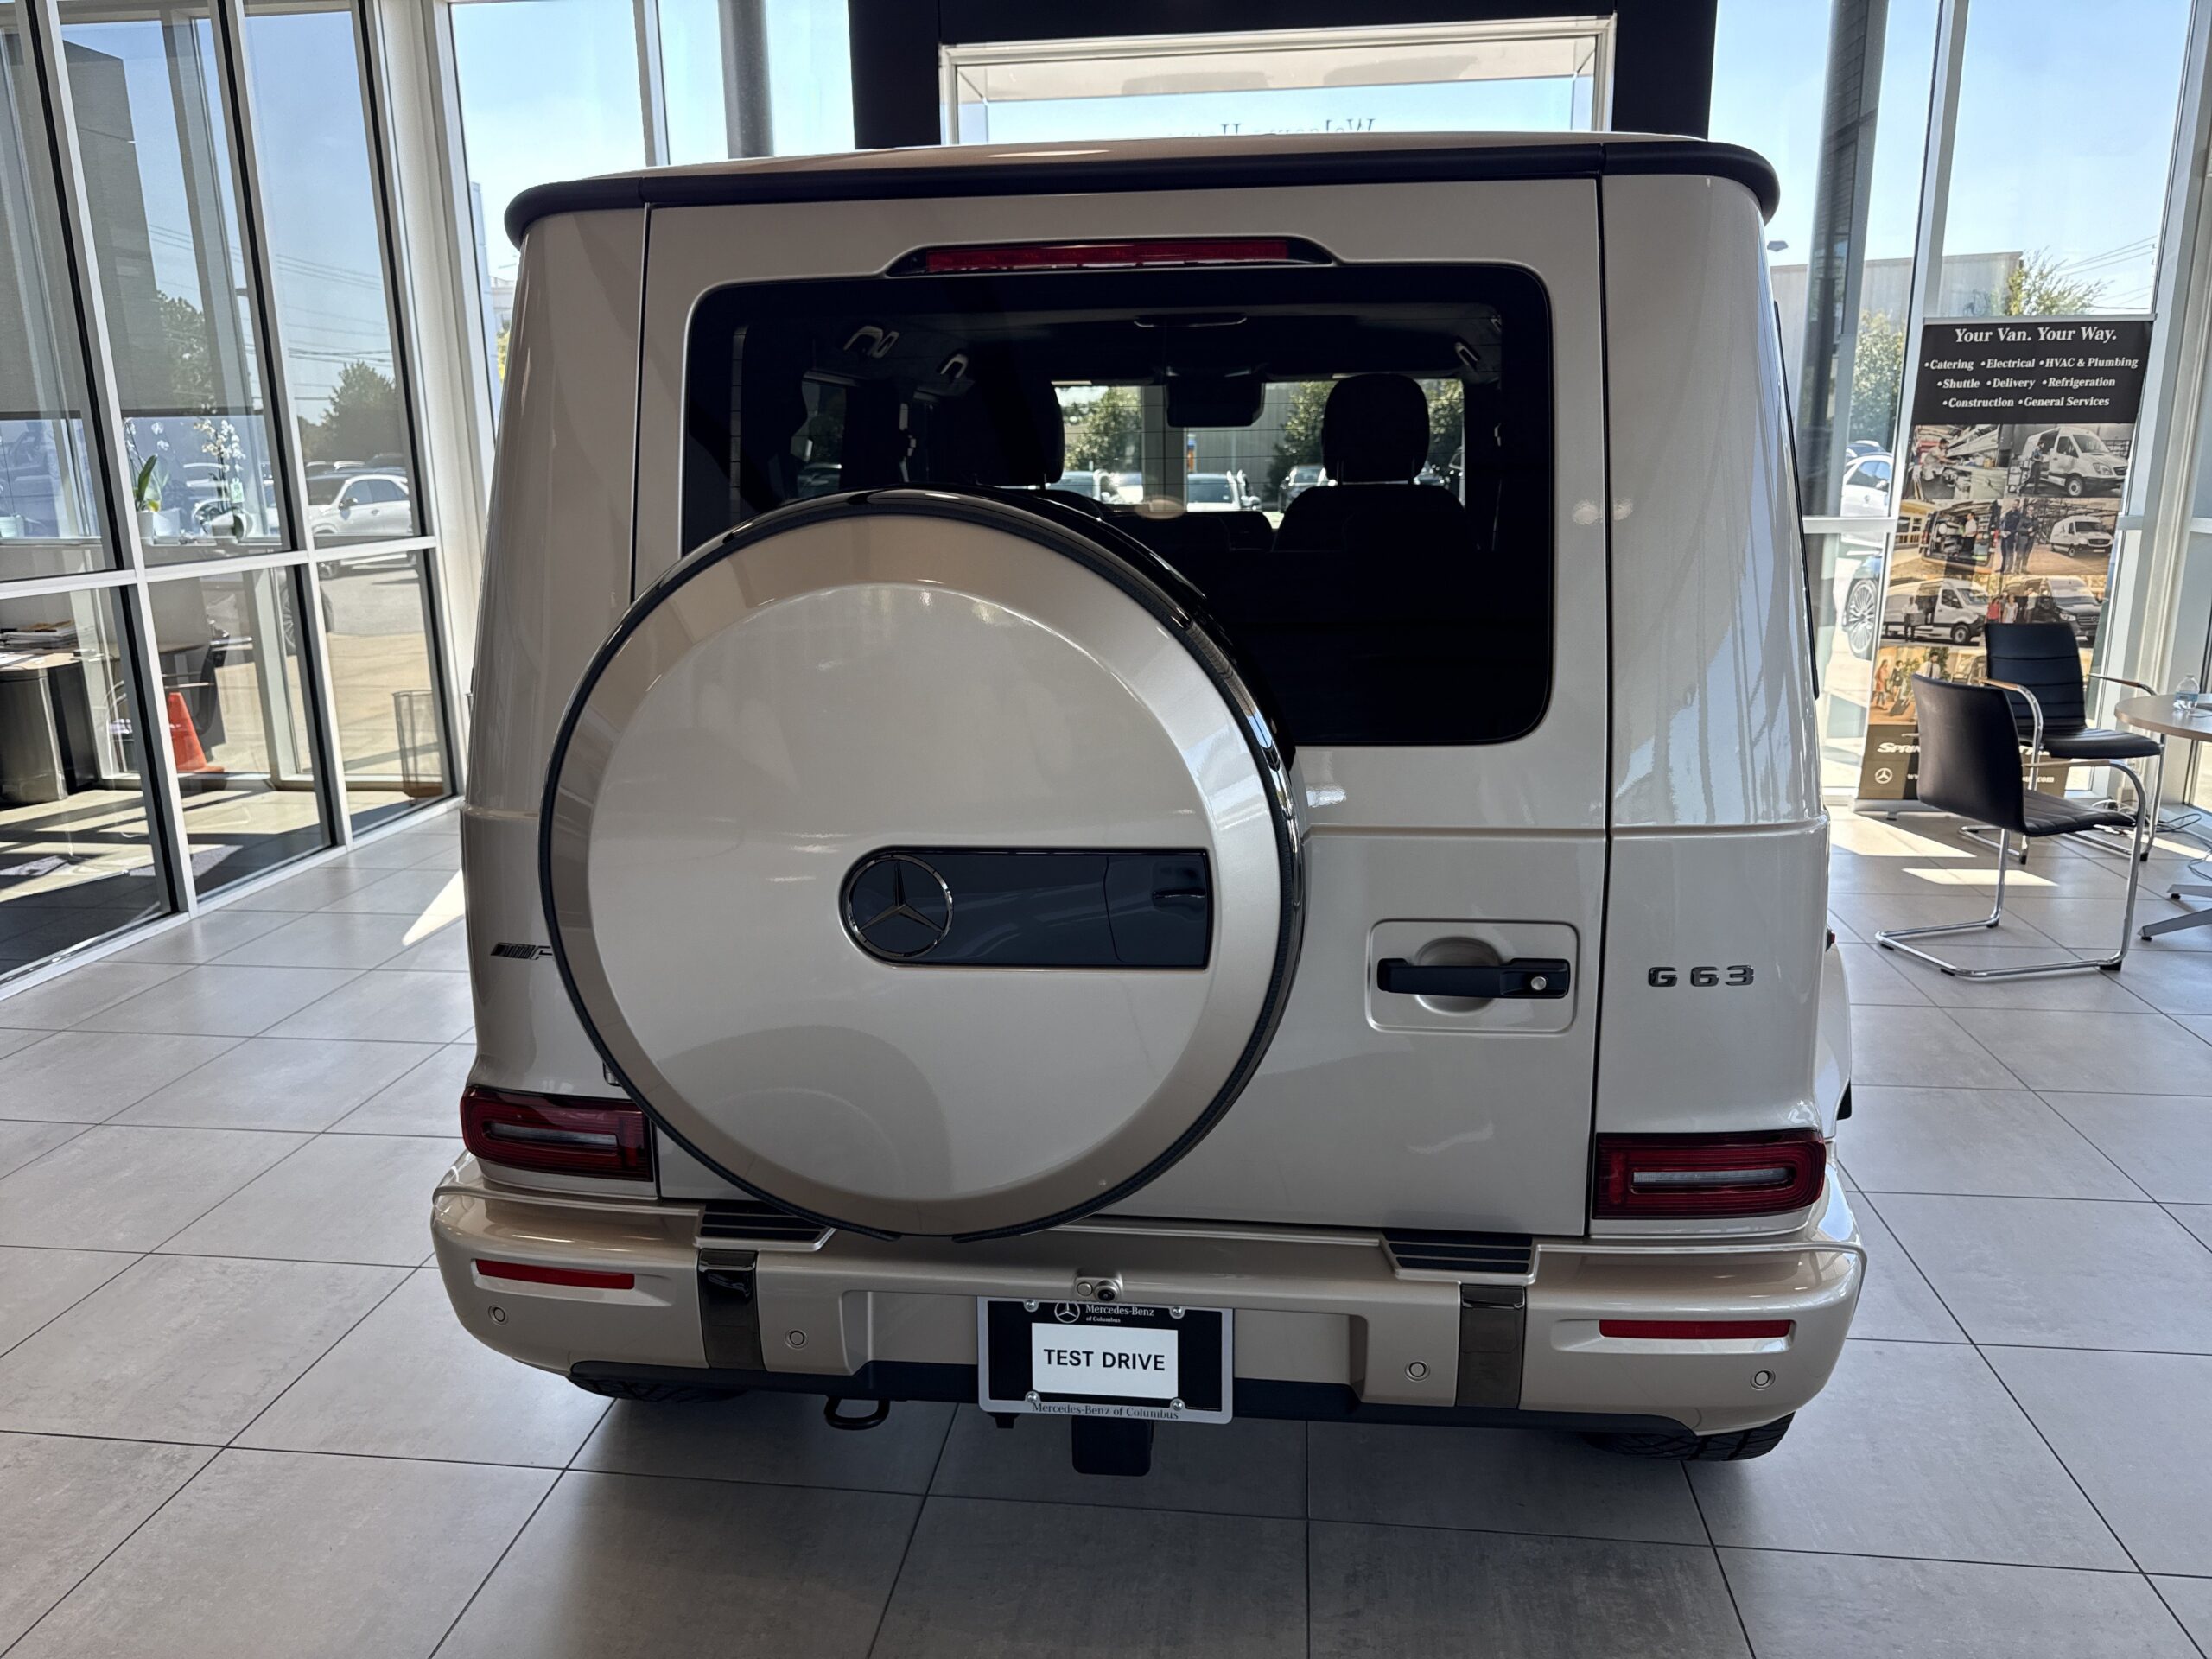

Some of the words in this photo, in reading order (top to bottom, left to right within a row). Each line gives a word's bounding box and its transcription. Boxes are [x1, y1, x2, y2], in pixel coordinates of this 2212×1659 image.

[1955, 327, 1993, 343] Your
[1997, 327, 2031, 342] Van.
[2037, 327, 2076, 341] Your
[2081, 325, 2117, 344] Way.
[1929, 359, 1974, 372] Catering
[1986, 358, 2036, 369] Electrical
[2044, 357, 2075, 368] HVAC
[2076, 357, 2085, 367] &
[2087, 356, 2139, 370] Plumbing
[1942, 378, 1980, 389] Shuttle
[1992, 377, 2036, 390] Delivery
[2048, 376, 2116, 390] Refrigeration
[1948, 397, 2014, 408] Construction
[2024, 396, 2065, 407] General
[2066, 395, 2110, 407] Services
[1647, 965, 1678, 988] G
[1689, 964, 1755, 988] 63
[1084, 1303, 1154, 1317] Mercedes-Benz
[1043, 1348, 1094, 1368] TEST
[1102, 1351, 1166, 1371] DRIVE
[1032, 1402, 1110, 1416] Mercedes-Benz
[1113, 1405, 1124, 1416] of
[1126, 1406, 1179, 1420] Columbus
